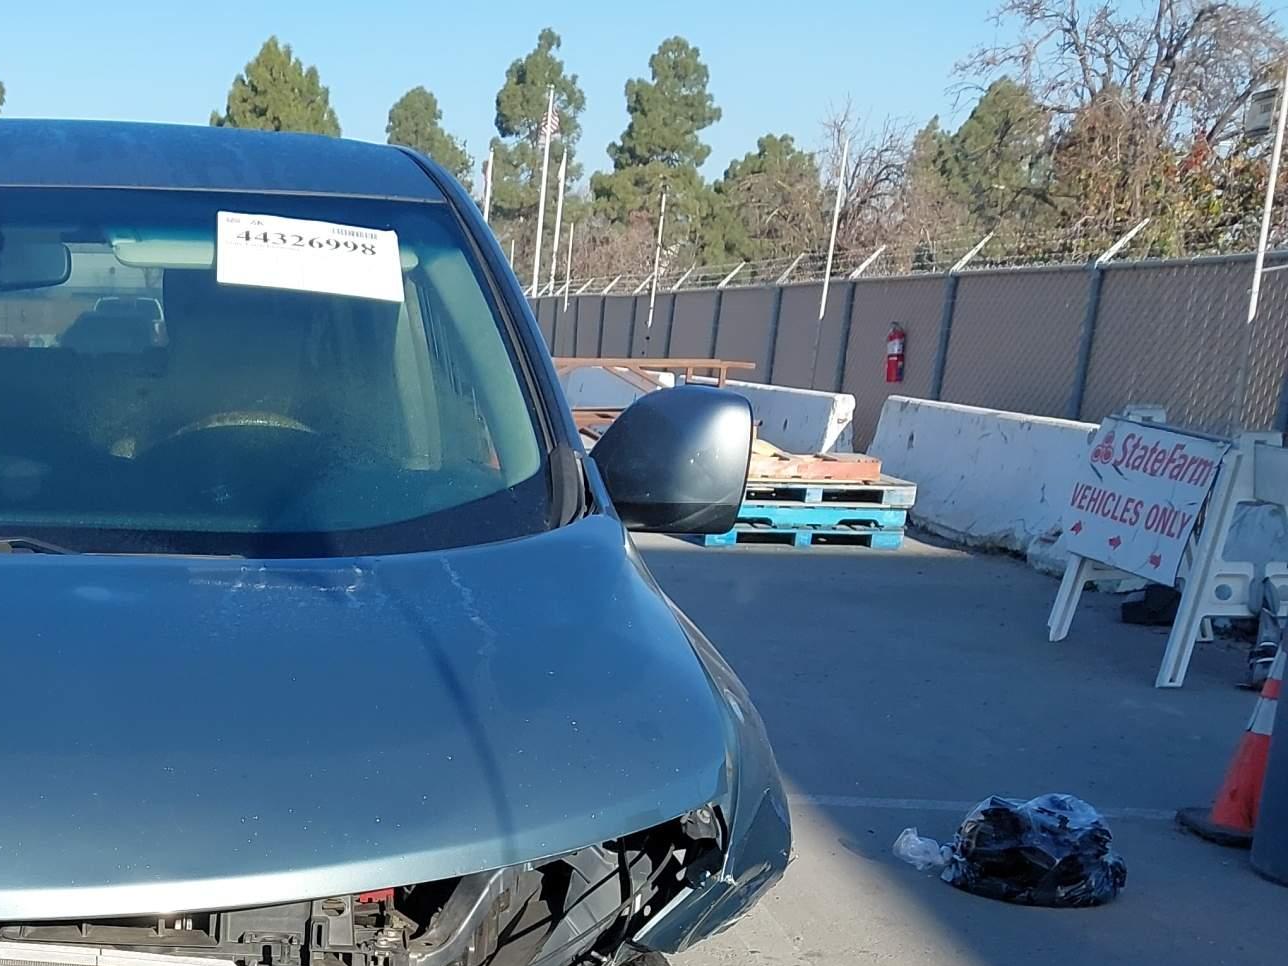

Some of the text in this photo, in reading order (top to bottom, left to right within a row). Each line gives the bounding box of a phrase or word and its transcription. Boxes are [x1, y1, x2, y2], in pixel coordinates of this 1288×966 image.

[236, 229, 377, 256] 44326998
[1070, 481, 1193, 540] VEHICLES ONLY
